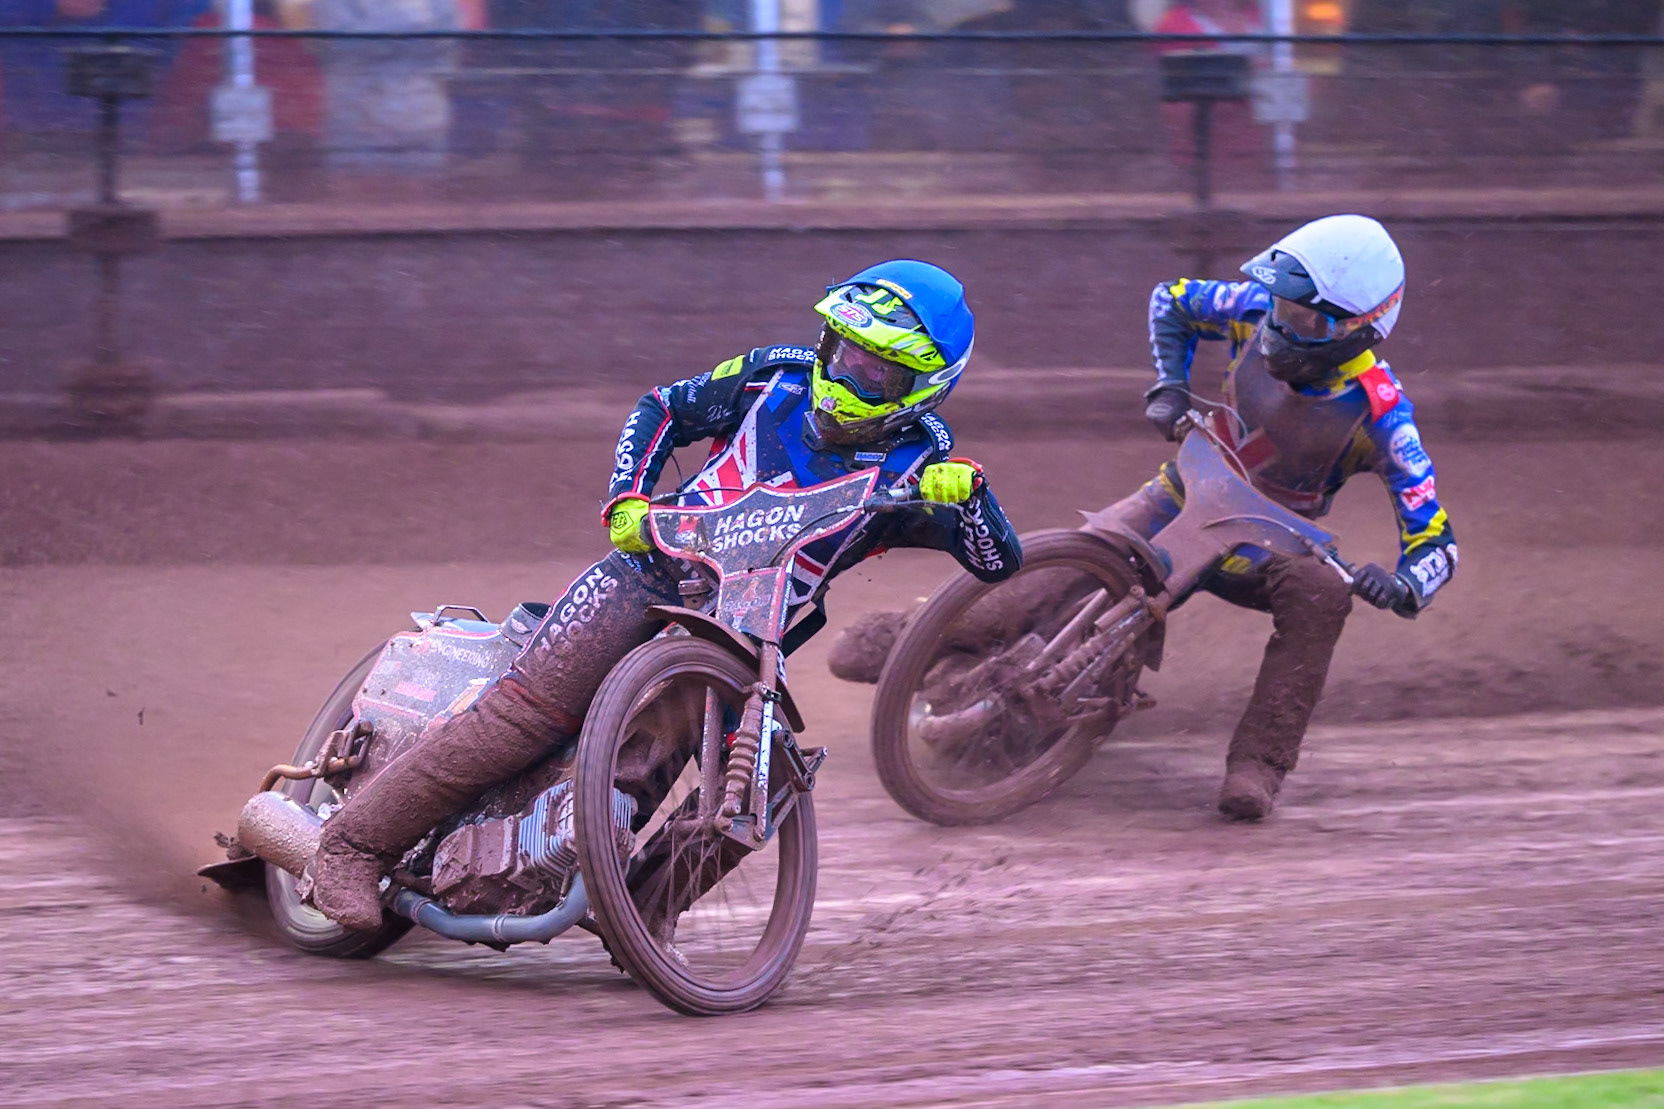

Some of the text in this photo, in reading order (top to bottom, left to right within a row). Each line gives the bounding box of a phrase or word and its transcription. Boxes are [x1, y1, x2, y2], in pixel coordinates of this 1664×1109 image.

[770, 347, 817, 358] HAGO
[920, 414, 947, 452] OCKS
[923, 411, 952, 451] AGON
[713, 504, 805, 537] HAGON
[711, 523, 802, 553] SHOCKS
